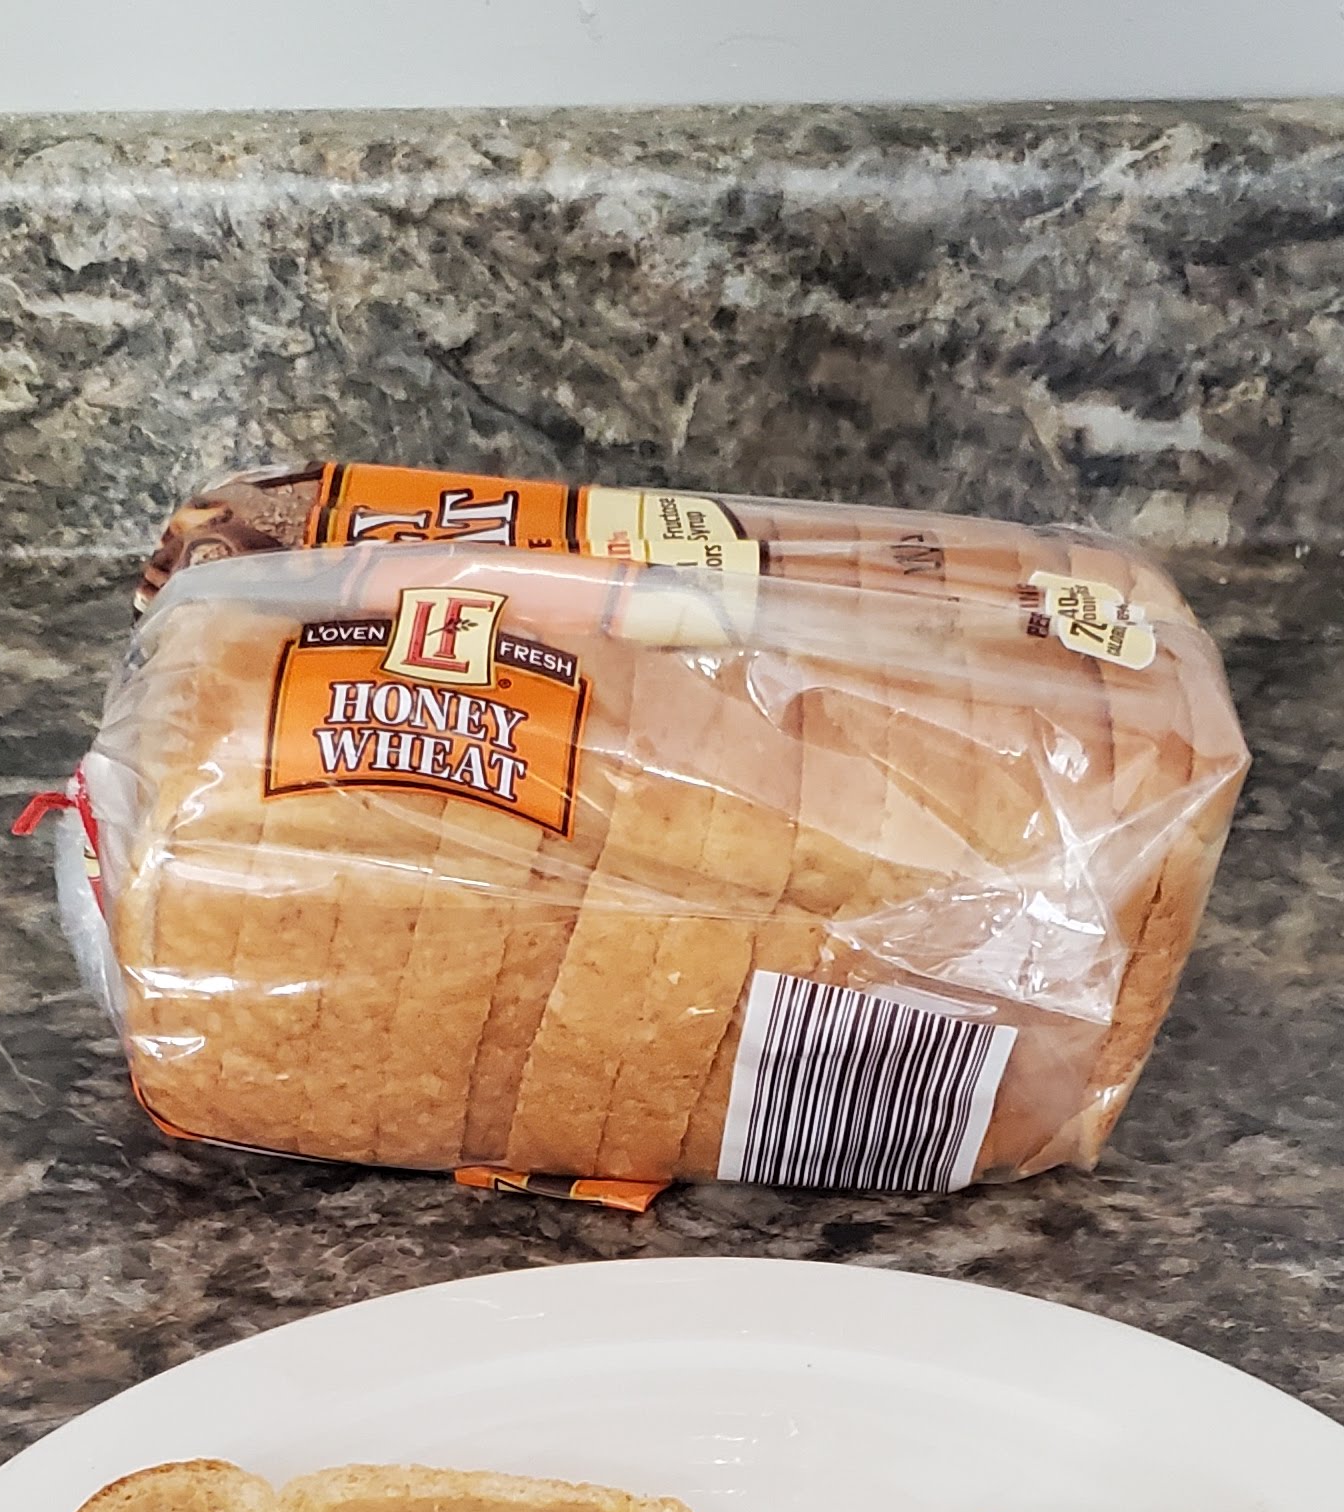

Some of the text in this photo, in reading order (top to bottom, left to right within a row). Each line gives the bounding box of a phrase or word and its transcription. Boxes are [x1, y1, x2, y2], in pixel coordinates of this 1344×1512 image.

[686, 511, 710, 541] Syrup
[306, 625, 572, 678] L'OVEN FRESH
[325, 680, 528, 751] HONEY
[314, 727, 527, 803] WHEAT
